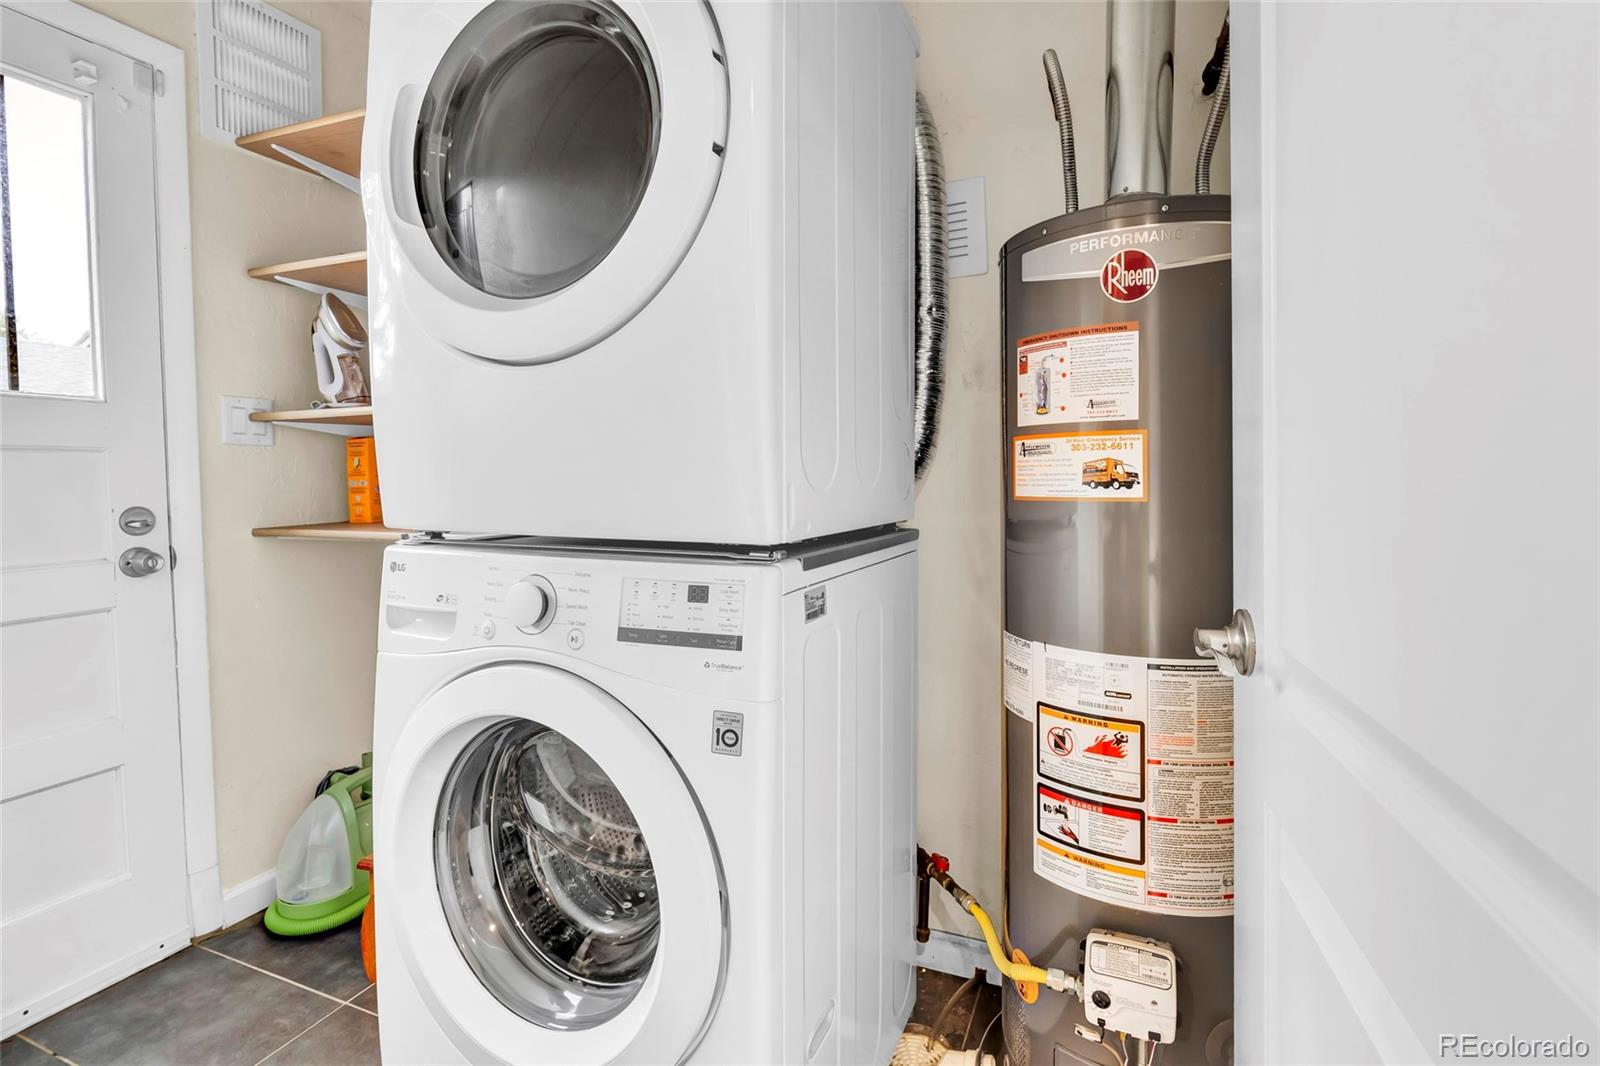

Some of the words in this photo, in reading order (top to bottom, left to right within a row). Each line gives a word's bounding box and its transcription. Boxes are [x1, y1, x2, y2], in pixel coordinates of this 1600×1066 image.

[1070, 228, 1200, 254] PERFORMANC
[1107, 251, 1154, 294] Rheem
[1080, 325, 1128, 335] INSTRUCTIONS
[1071, 442, 1134, 452] 303-232-6611
[1071, 716, 1108, 728] WARNING
[715, 727, 739, 748] 10
[1071, 800, 1103, 812] DANGER
[1072, 856, 1105, 869] WARNING
